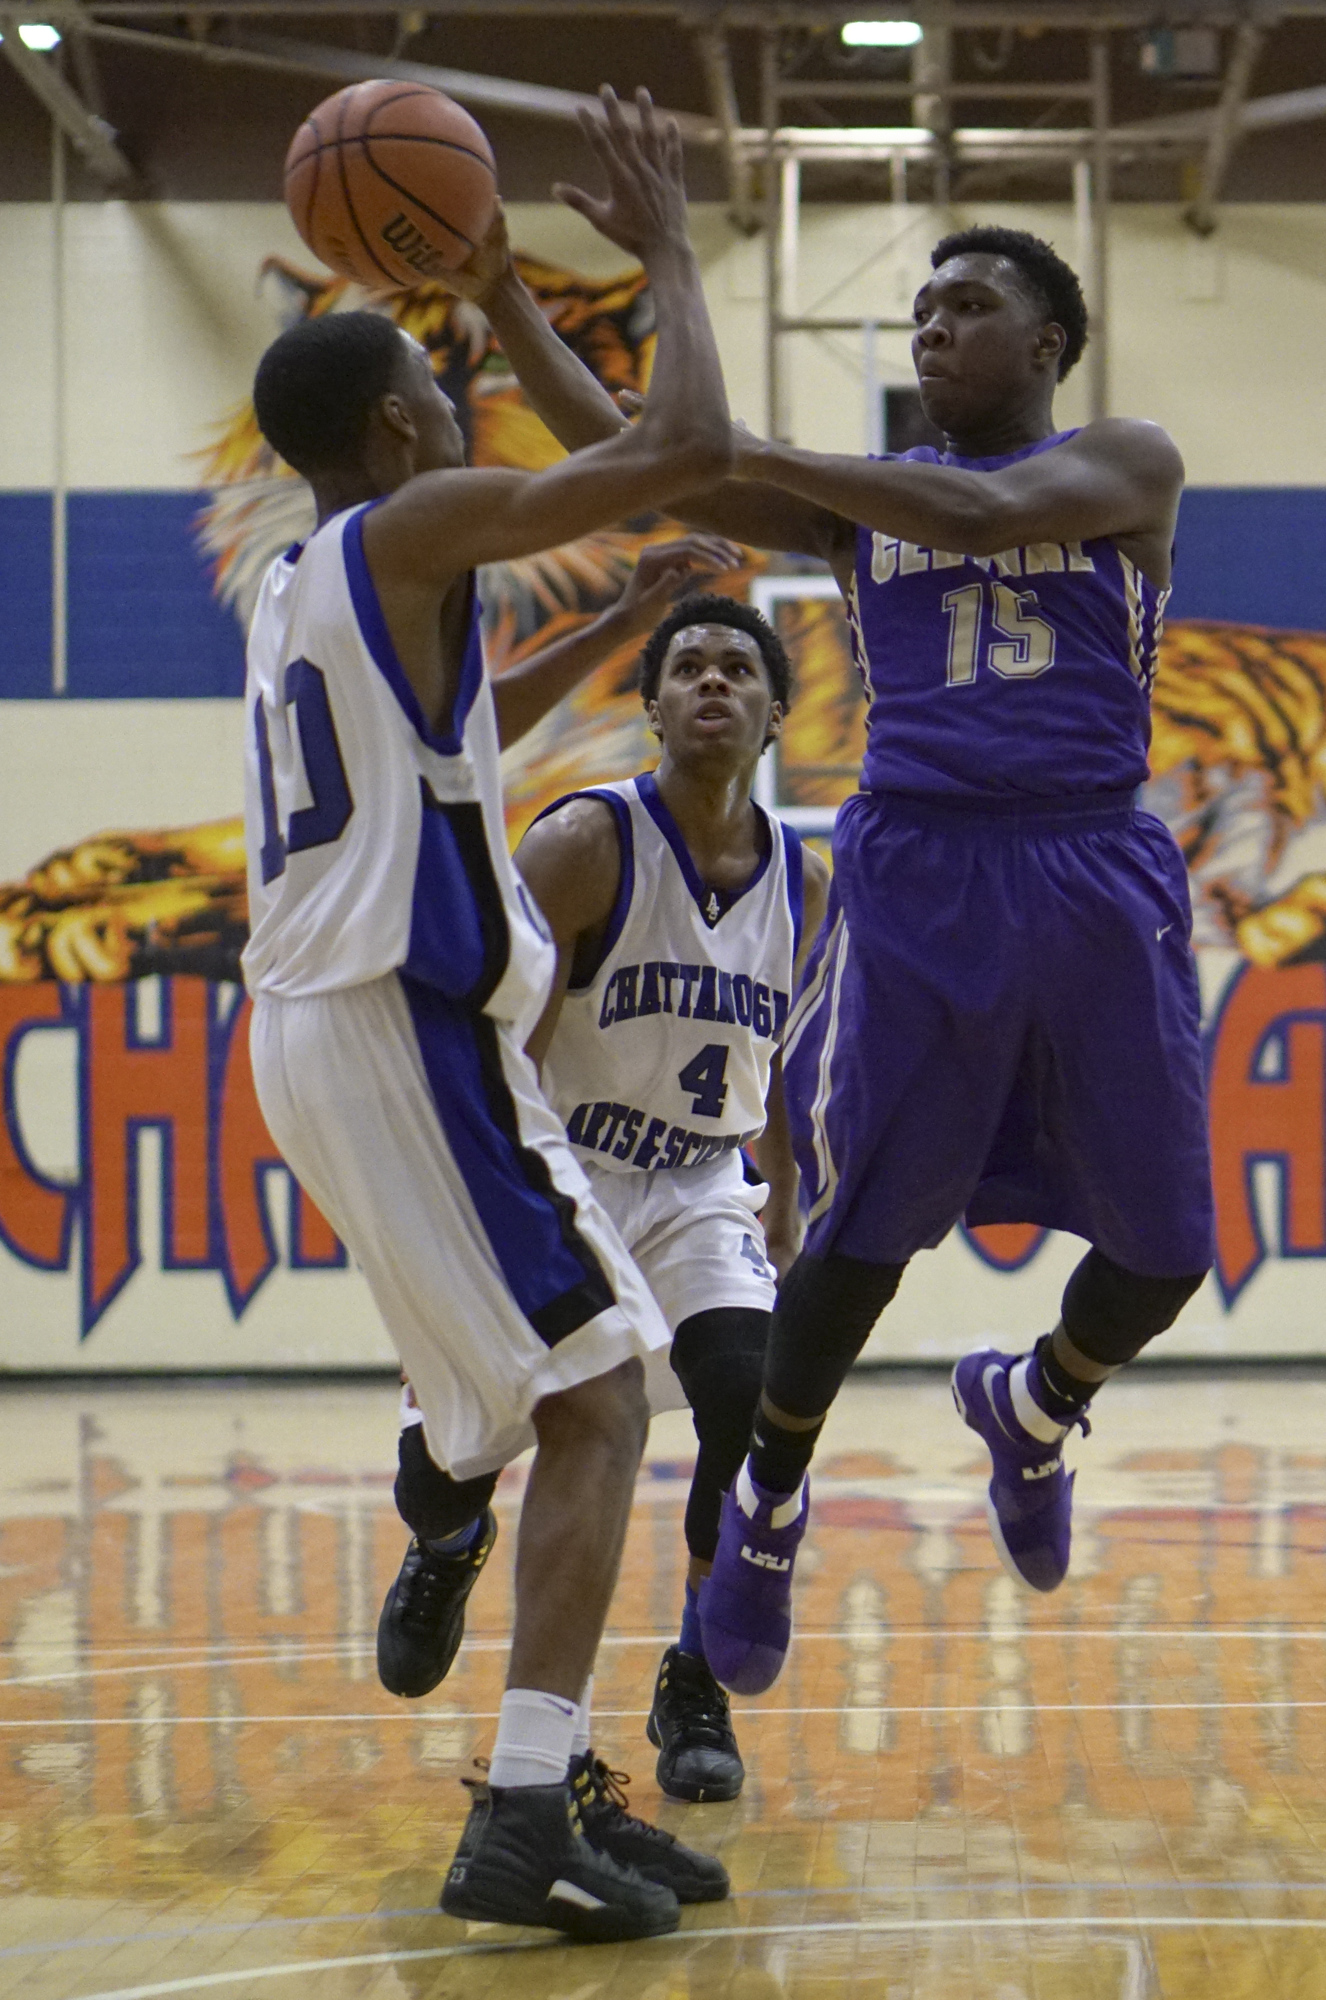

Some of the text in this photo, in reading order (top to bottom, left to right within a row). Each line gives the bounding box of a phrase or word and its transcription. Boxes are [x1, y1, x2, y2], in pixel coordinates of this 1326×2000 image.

[382, 212, 444, 276] Wil
[942, 582, 1056, 688] 15
[678, 1043, 730, 1118] 4
[450, 1866, 466, 1884] 23
